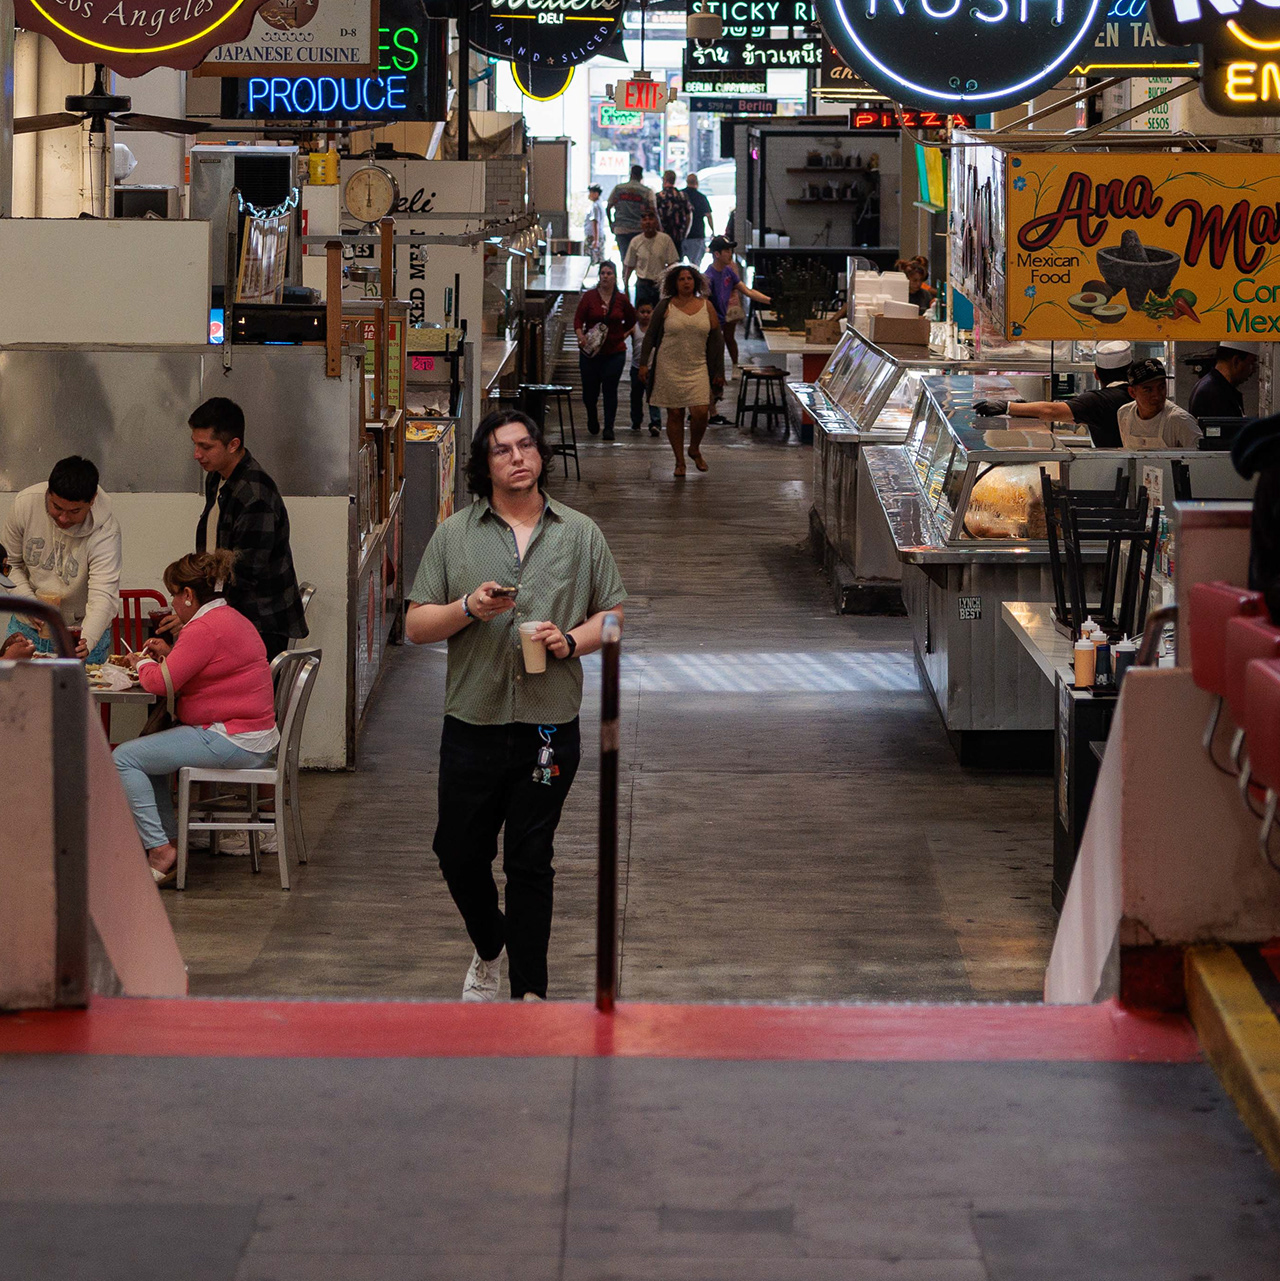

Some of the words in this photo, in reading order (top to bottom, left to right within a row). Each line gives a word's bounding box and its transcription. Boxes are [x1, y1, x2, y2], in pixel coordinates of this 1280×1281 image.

[340, 28, 357, 38] D-8
[495, 23, 540, 62] HAND
[562, 26, 608, 63] SLICED
[215, 46, 293, 63] JAPANESE
[297, 47, 360, 63] CUISINE
[248, 76, 407, 113] PRODUCE
[625, 82, 660, 109] EXIT
[738, 100, 773, 111] Berlin
[854, 112, 970, 128] PIZZA
[1148, 117, 1169, 129] SESOS
[600, 157, 624, 167] ATM
[1017, 171, 1164, 252] Ana
[1017, 253, 1080, 268] Mexican
[1030, 269, 1071, 284] Food
[23, 537, 79, 586] GAP
[960, 609, 981, 619] BEST
